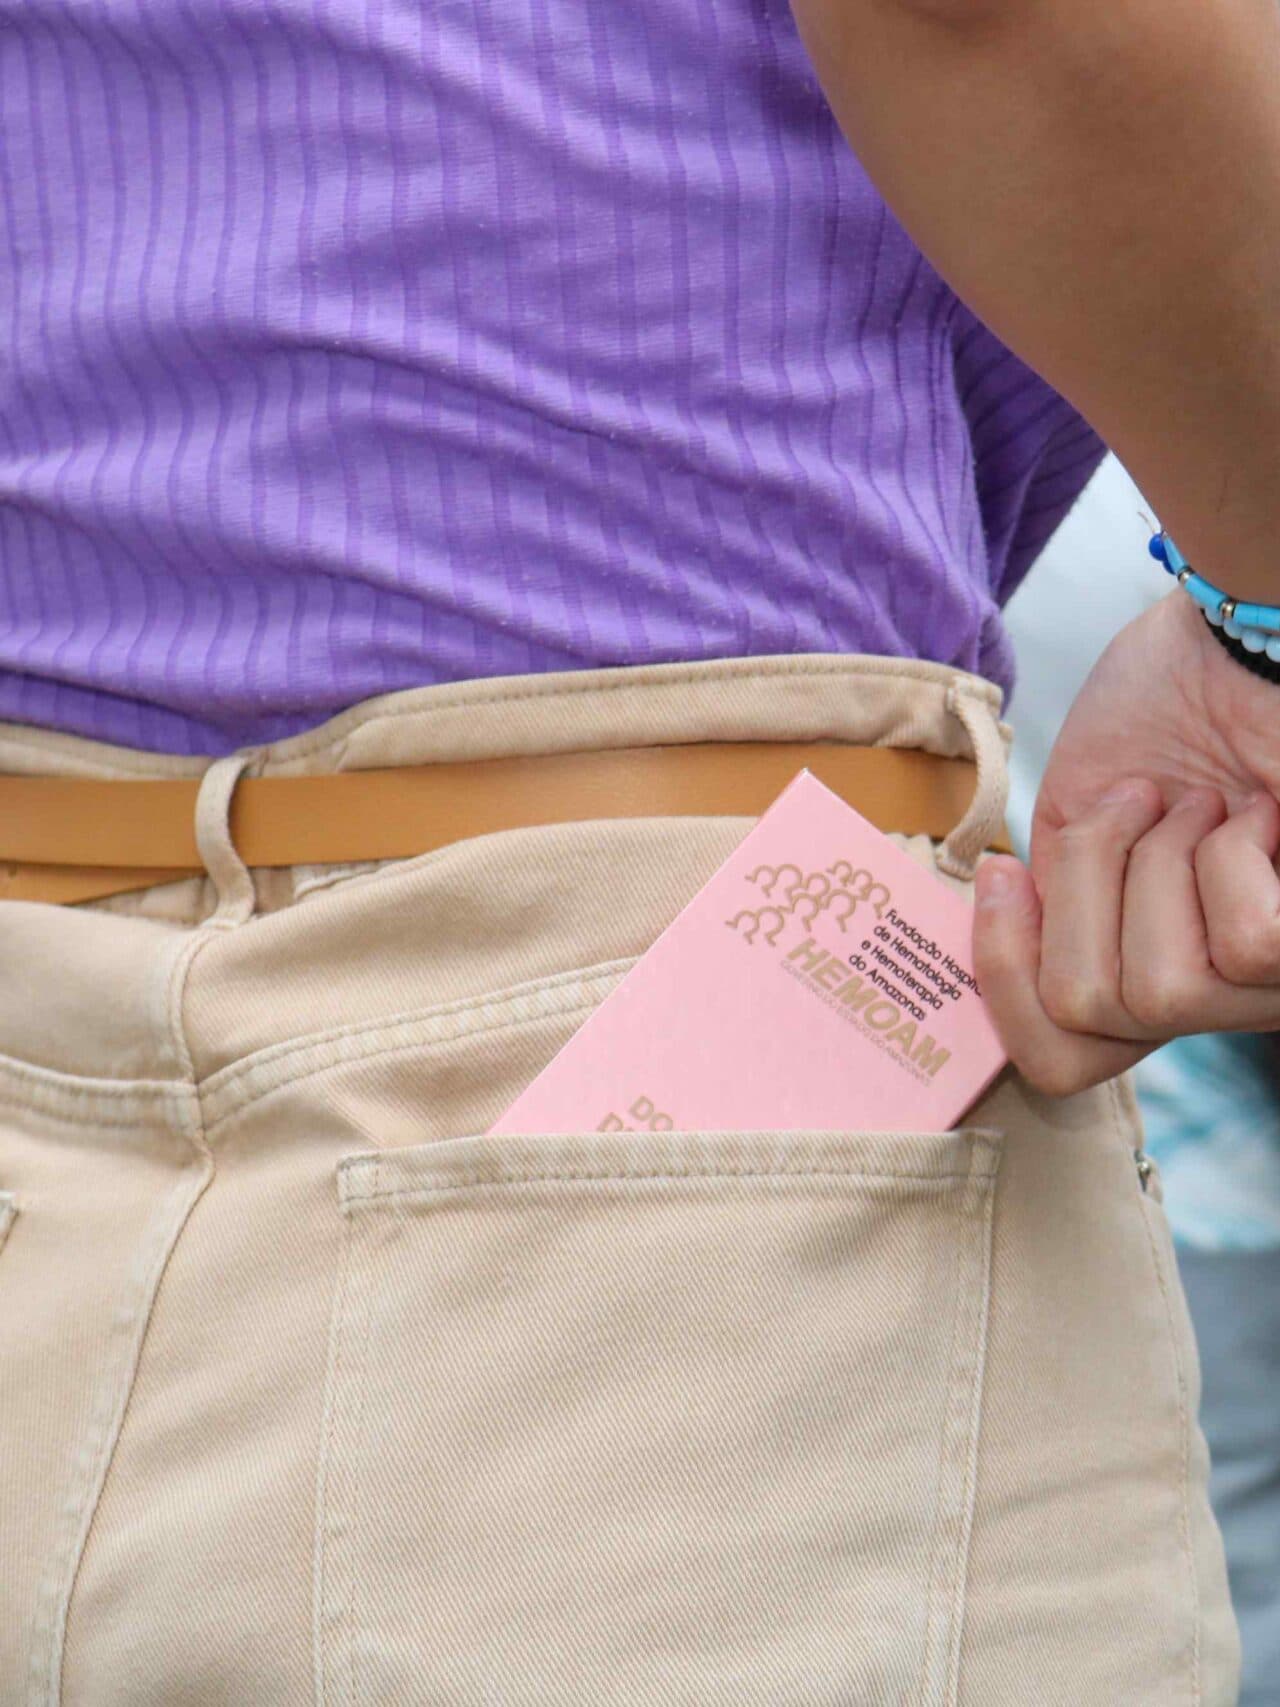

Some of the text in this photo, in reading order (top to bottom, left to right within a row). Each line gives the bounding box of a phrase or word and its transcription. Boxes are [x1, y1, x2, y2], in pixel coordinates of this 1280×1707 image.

[873, 925, 961, 1001] de Hematologia
[885, 909, 941, 960] Fundação
[786, 937, 951, 1077] HEMOAM
[848, 954, 927, 1021] do Amazonas
[861, 940, 943, 1010] e Hemoterapia
